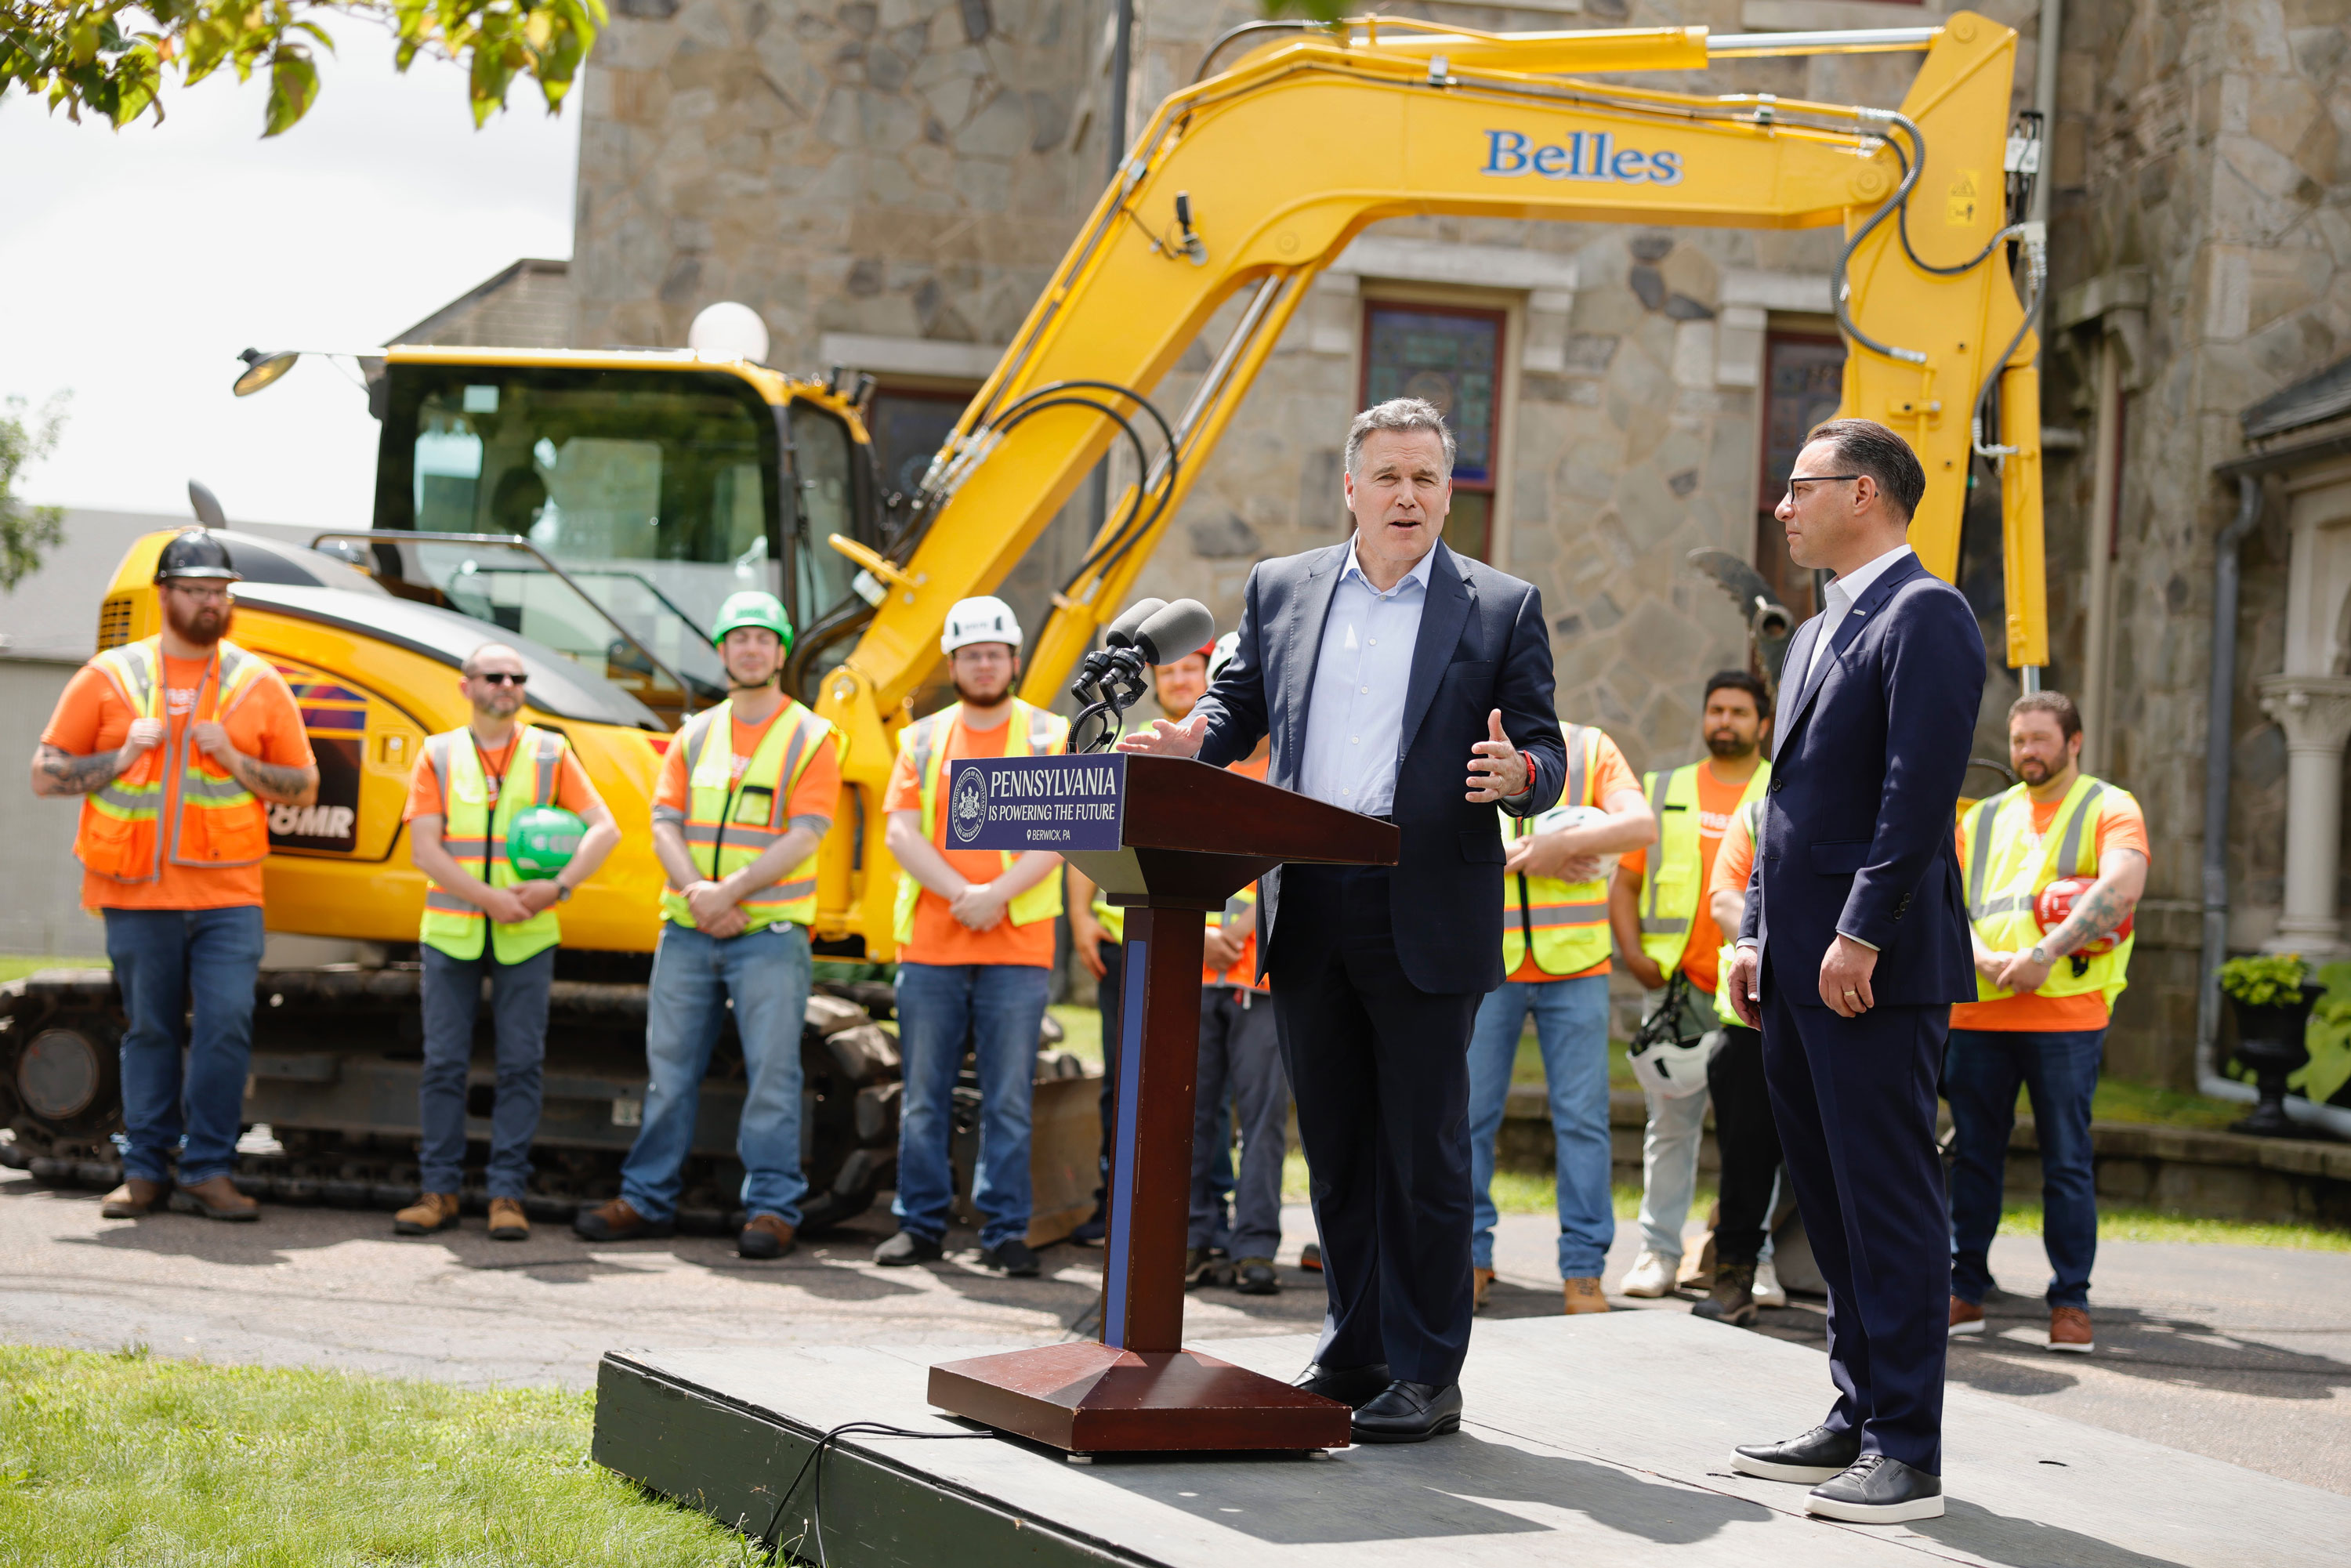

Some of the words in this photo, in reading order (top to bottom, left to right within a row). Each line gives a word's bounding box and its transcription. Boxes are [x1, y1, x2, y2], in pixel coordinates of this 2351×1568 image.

[1479, 129, 1684, 186] Belles
[990, 767, 1117, 798] PENNSYLVANIA
[264, 799, 355, 838] 8MR
[988, 806, 998, 821] IS
[999, 804, 1052, 821] POWERING
[1054, 804, 1074, 820] THE
[1075, 803, 1116, 820] FUTURE
[1032, 829, 1062, 842] BERWICK,
[1063, 829, 1070, 841] PA
